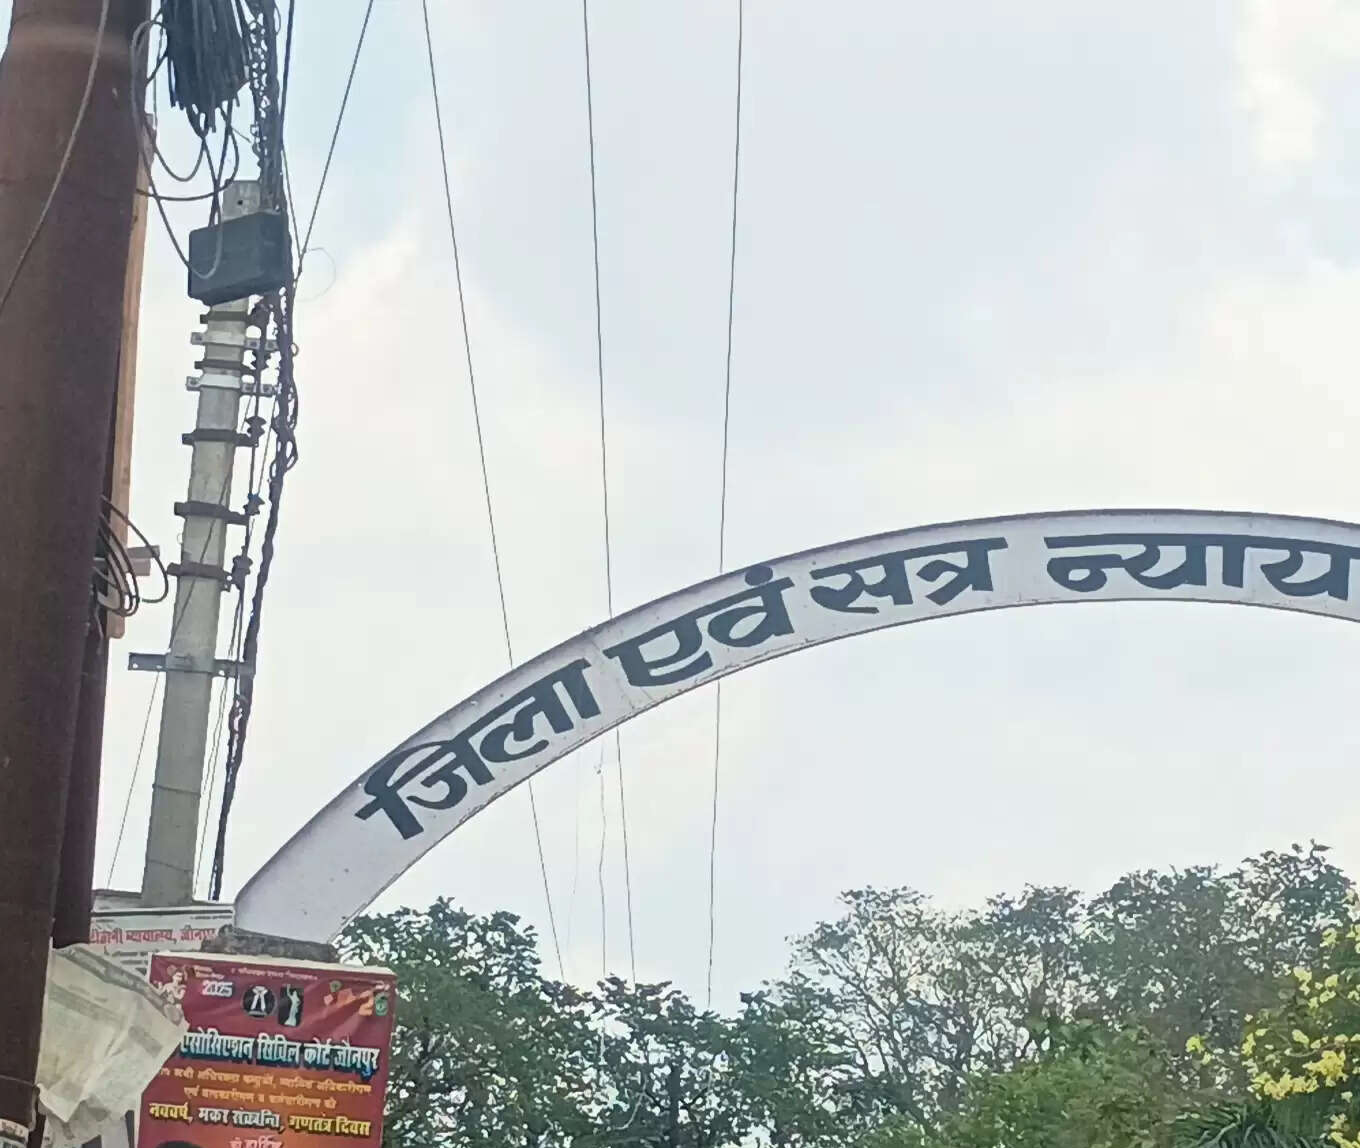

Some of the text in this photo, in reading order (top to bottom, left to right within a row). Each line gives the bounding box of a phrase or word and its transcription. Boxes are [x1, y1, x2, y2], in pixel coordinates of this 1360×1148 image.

[355, 658, 601, 840] जिला
[602, 565, 795, 688] एवं
[810, 536, 1009, 614] सत्र
